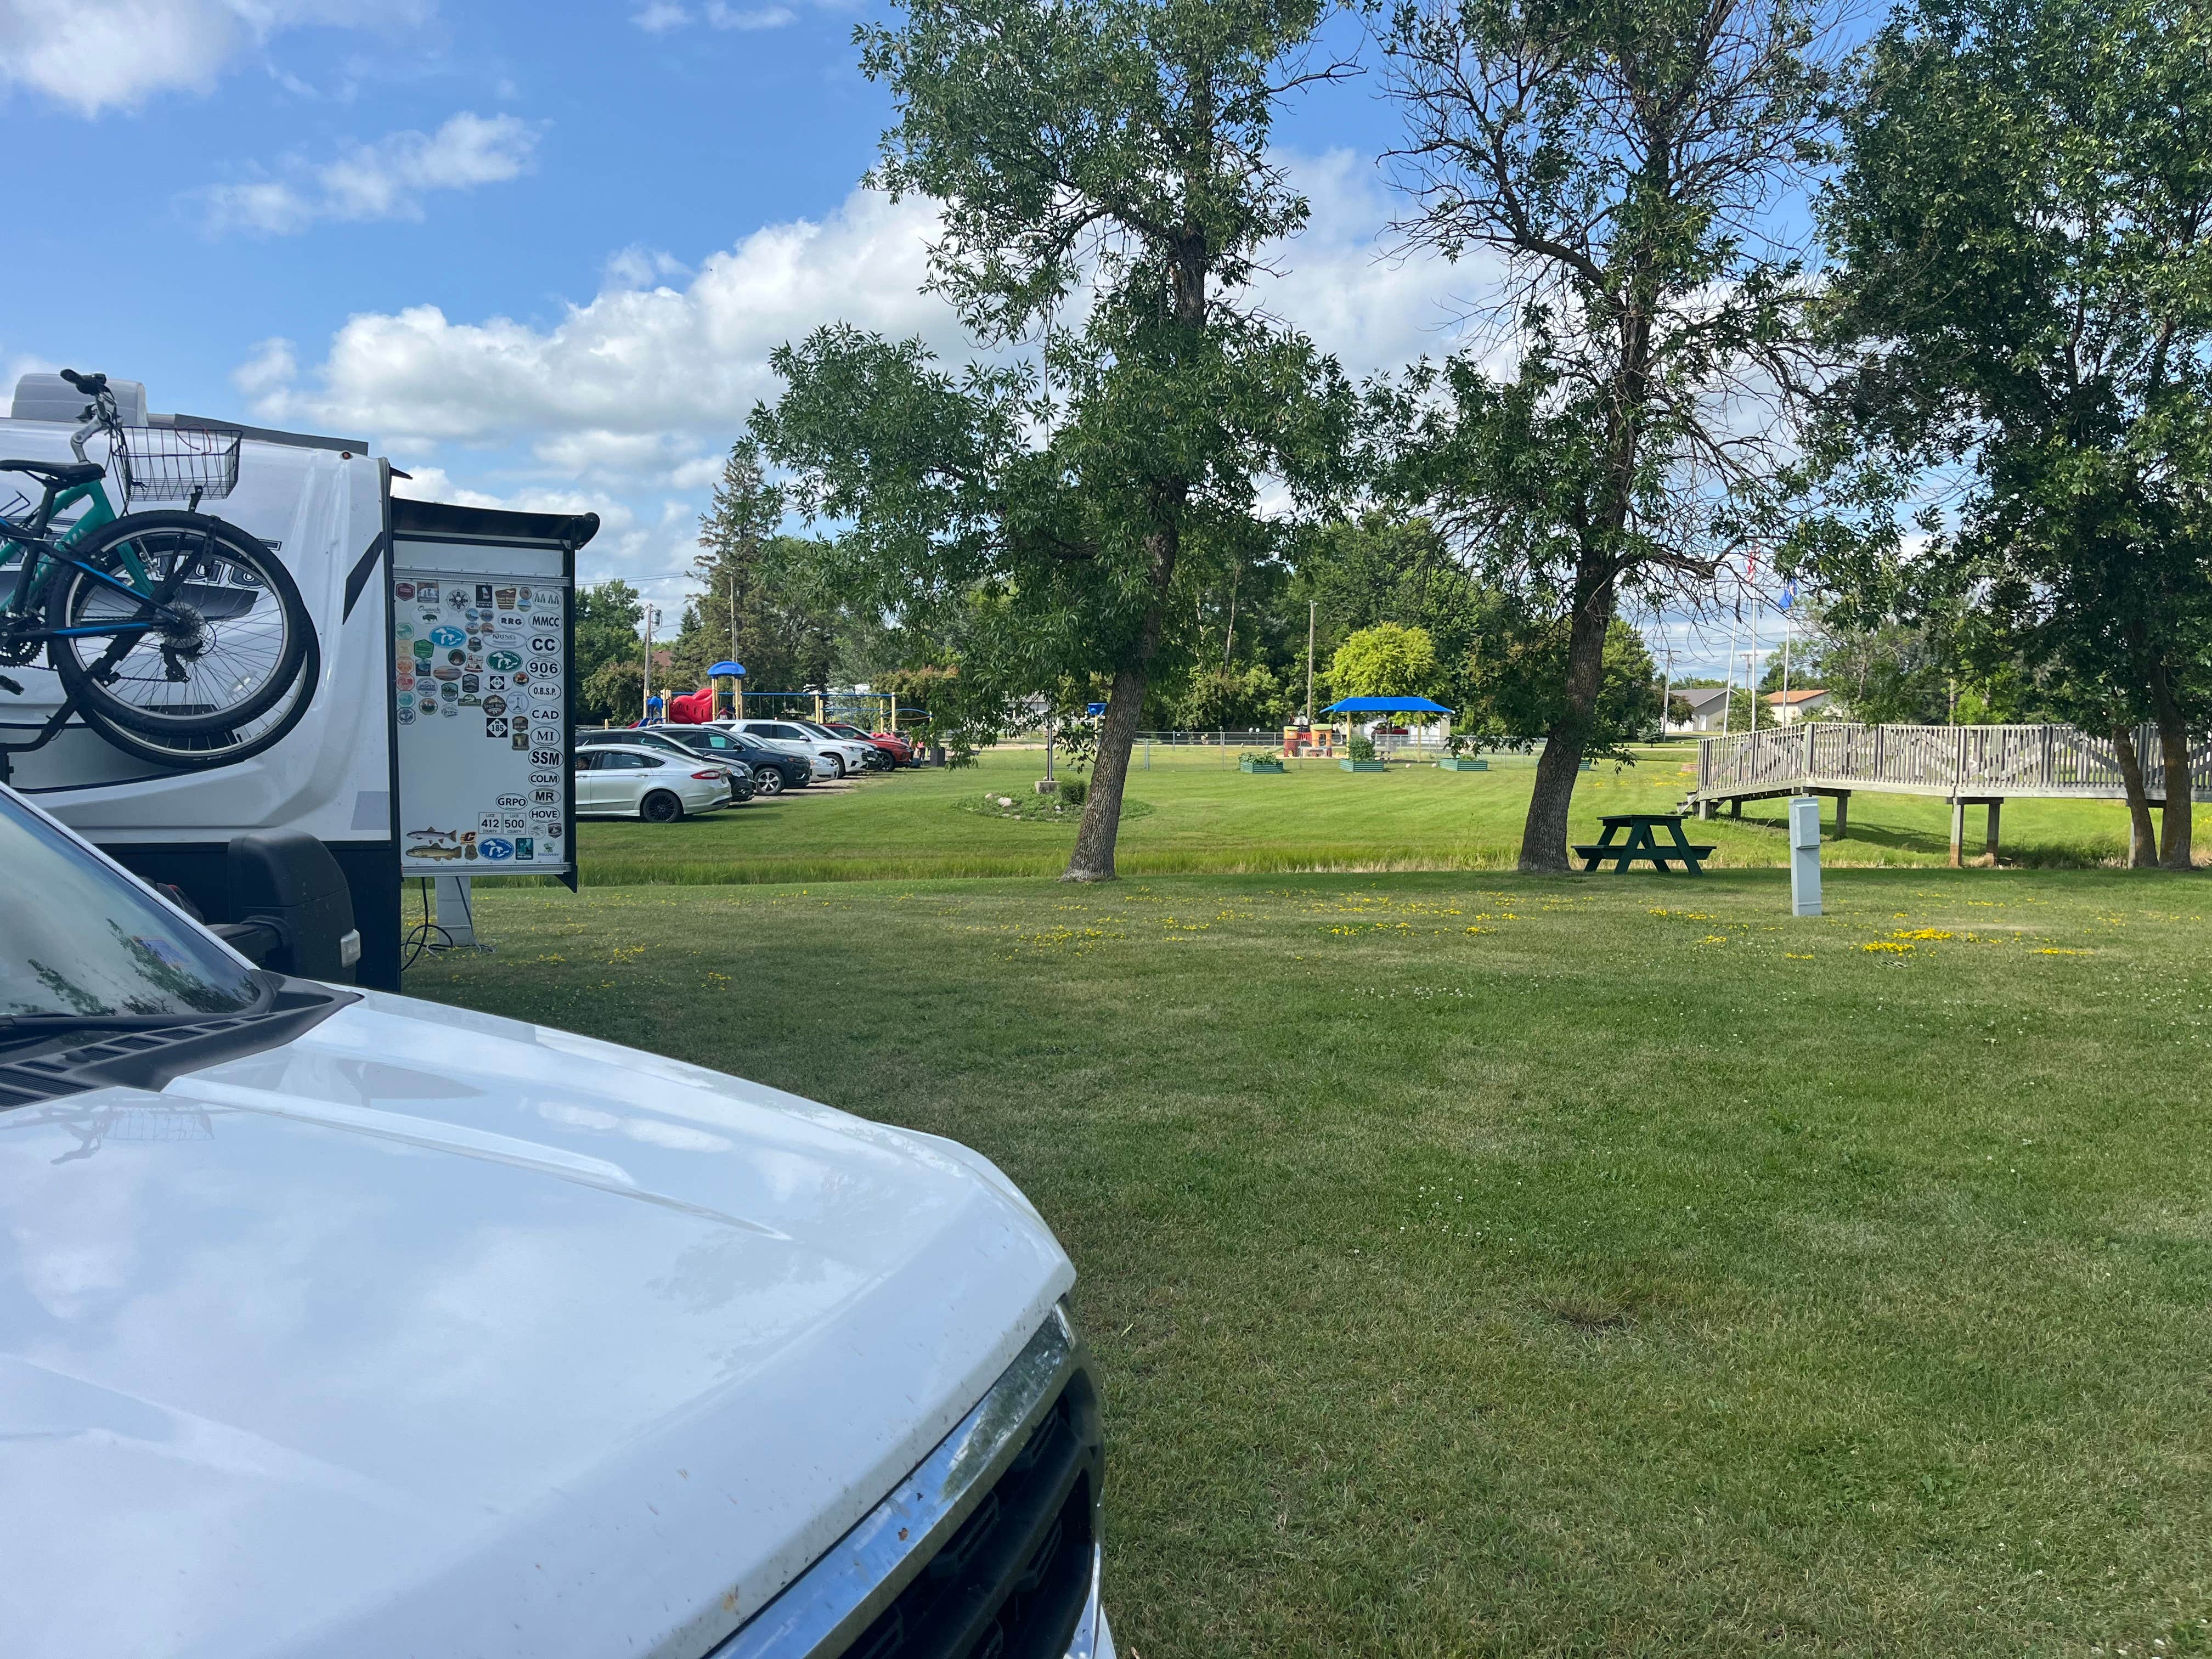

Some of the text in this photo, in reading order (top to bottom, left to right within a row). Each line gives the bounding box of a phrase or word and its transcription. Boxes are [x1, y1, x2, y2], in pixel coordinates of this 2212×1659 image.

[532, 616, 559, 627] MMCC
[532, 639, 555, 651] CC
[530, 663, 558, 673] 906
[533, 687, 556, 696] O.B.S.P.
[532, 710, 559, 719] CAD
[537, 731, 554, 741] MI
[532, 751, 559, 765] SSM
[535, 792, 554, 801] MR
[481, 819, 499, 827] 412
[505, 820, 524, 828] 500
